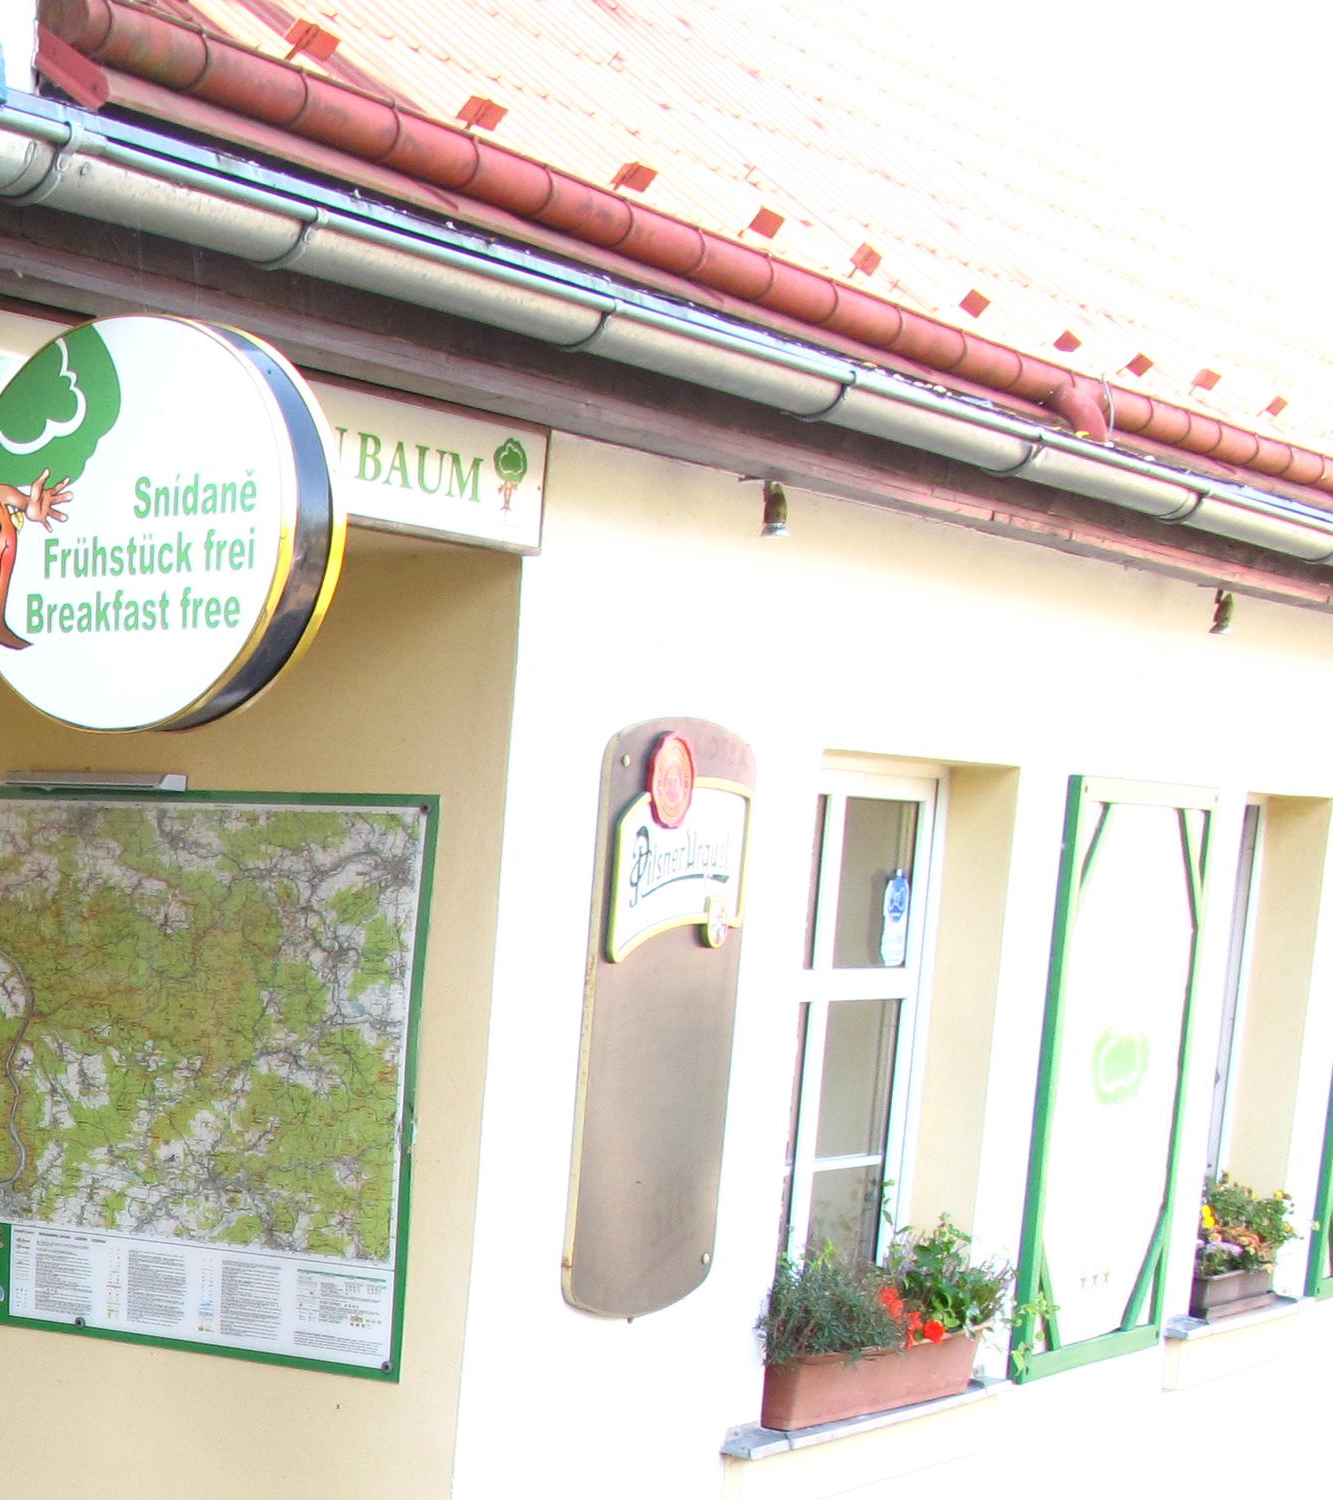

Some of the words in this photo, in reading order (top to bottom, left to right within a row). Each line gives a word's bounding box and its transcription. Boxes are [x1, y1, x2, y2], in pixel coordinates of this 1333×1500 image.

[355, 431, 485, 503] BAUM
[133, 469, 258, 521] Snídaně
[43, 533, 191, 580] Frühstück
[202, 525, 257, 570] frei
[26, 590, 170, 636] Breakfast
[180, 588, 241, 629] free
[630, 826, 686, 908] Pilsner
[687, 830, 730, 871] Urquel
